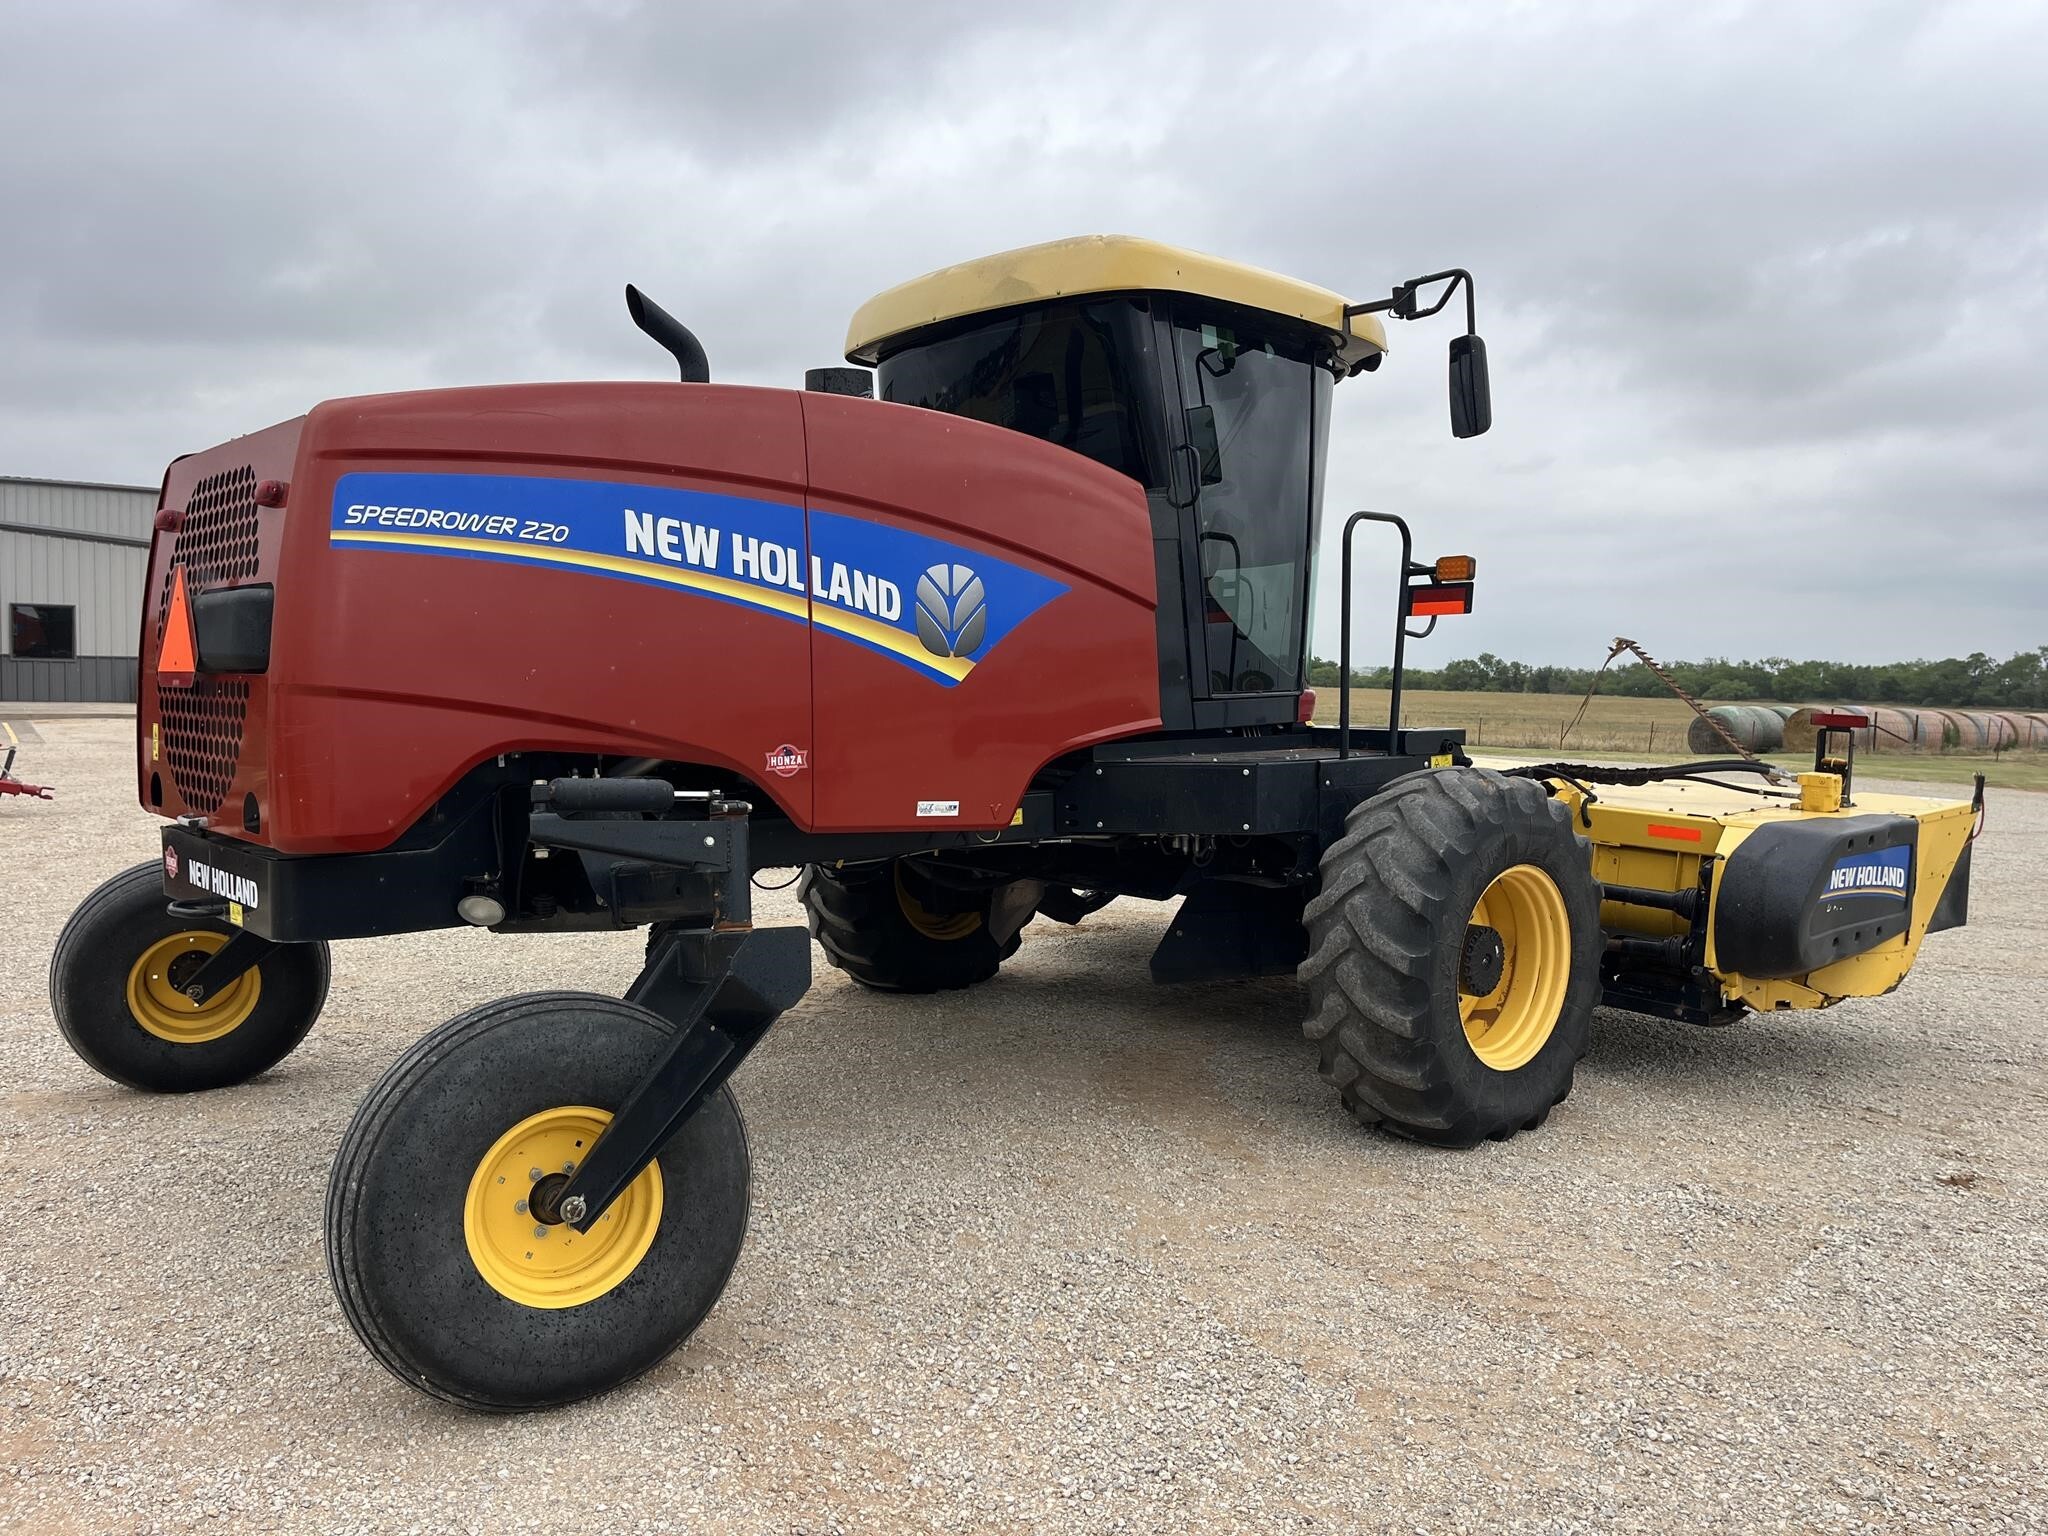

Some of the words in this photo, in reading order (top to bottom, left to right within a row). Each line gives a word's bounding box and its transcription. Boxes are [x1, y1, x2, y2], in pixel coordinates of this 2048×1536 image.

[344, 504, 518, 535] SPEEDROWER
[519, 520, 570, 542] 220
[624, 508, 720, 569] NEW
[731, 532, 902, 622] HOLLAND
[770, 754, 803, 767] HONZA
[188, 858, 210, 891] NEW
[211, 866, 259, 909] HOLLAND
[1830, 866, 1857, 890] NEW
[1856, 865, 1905, 888] HOLLAND
